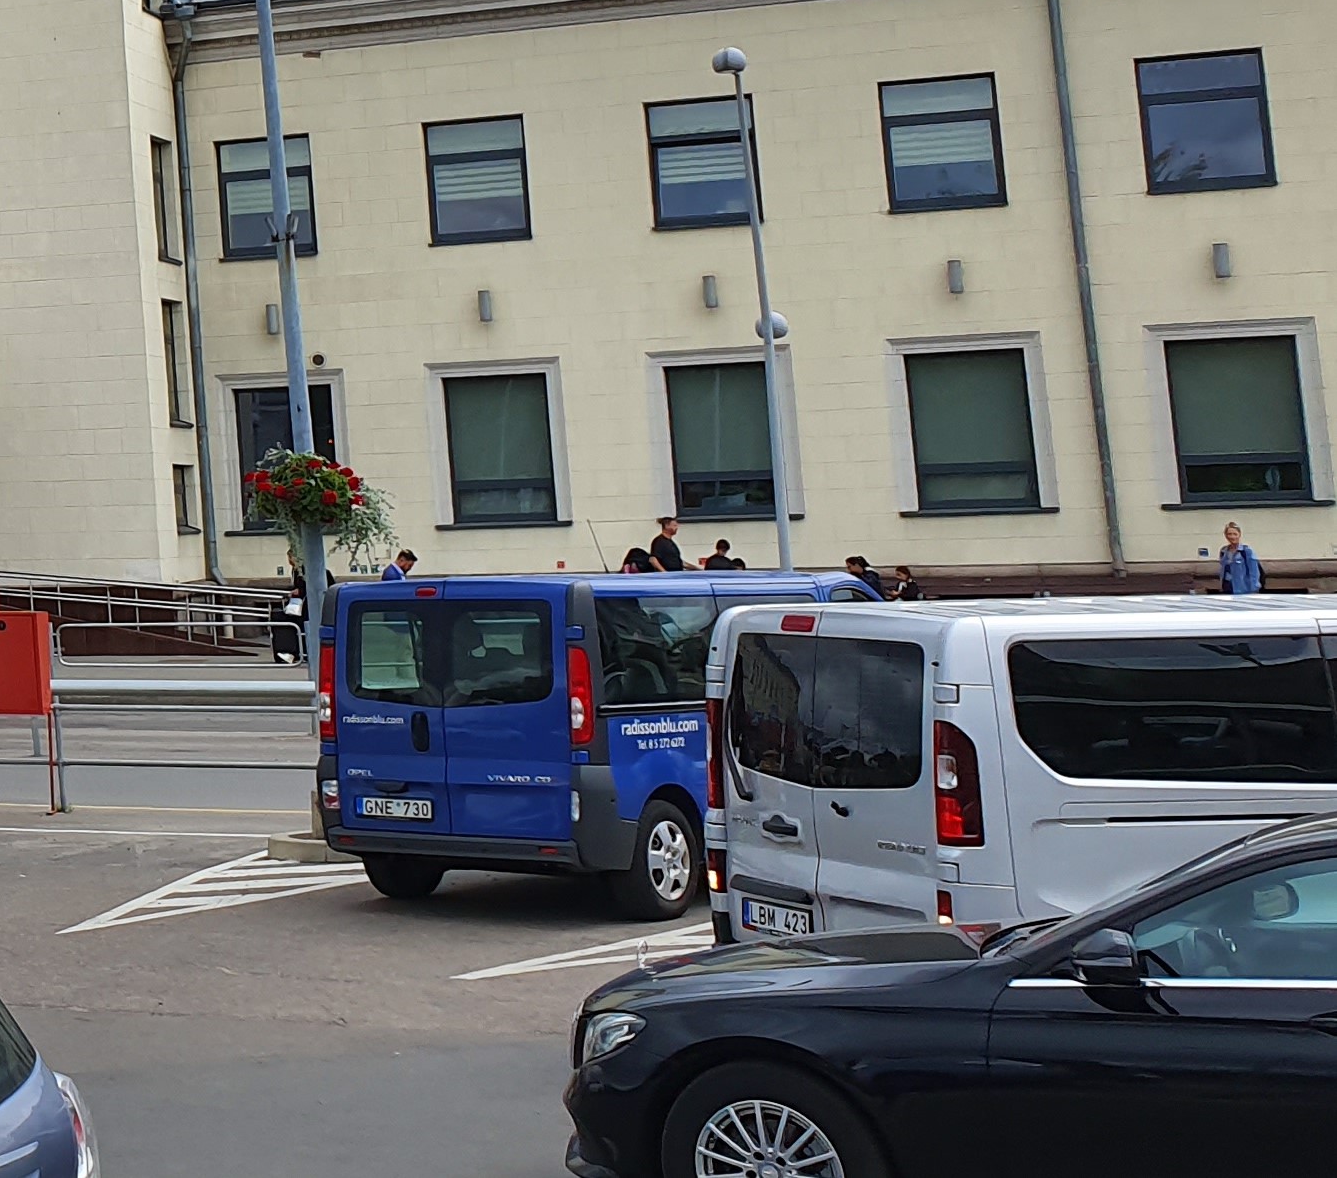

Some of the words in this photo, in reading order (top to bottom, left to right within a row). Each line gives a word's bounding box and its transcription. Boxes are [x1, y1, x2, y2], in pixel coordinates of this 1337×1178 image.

[621, 717, 699, 735] radissonblu.com
[365, 800, 393, 815] GNE
[403, 802, 429, 817] 730
[750, 903, 776, 928] LBM
[784, 910, 807, 935] 423
